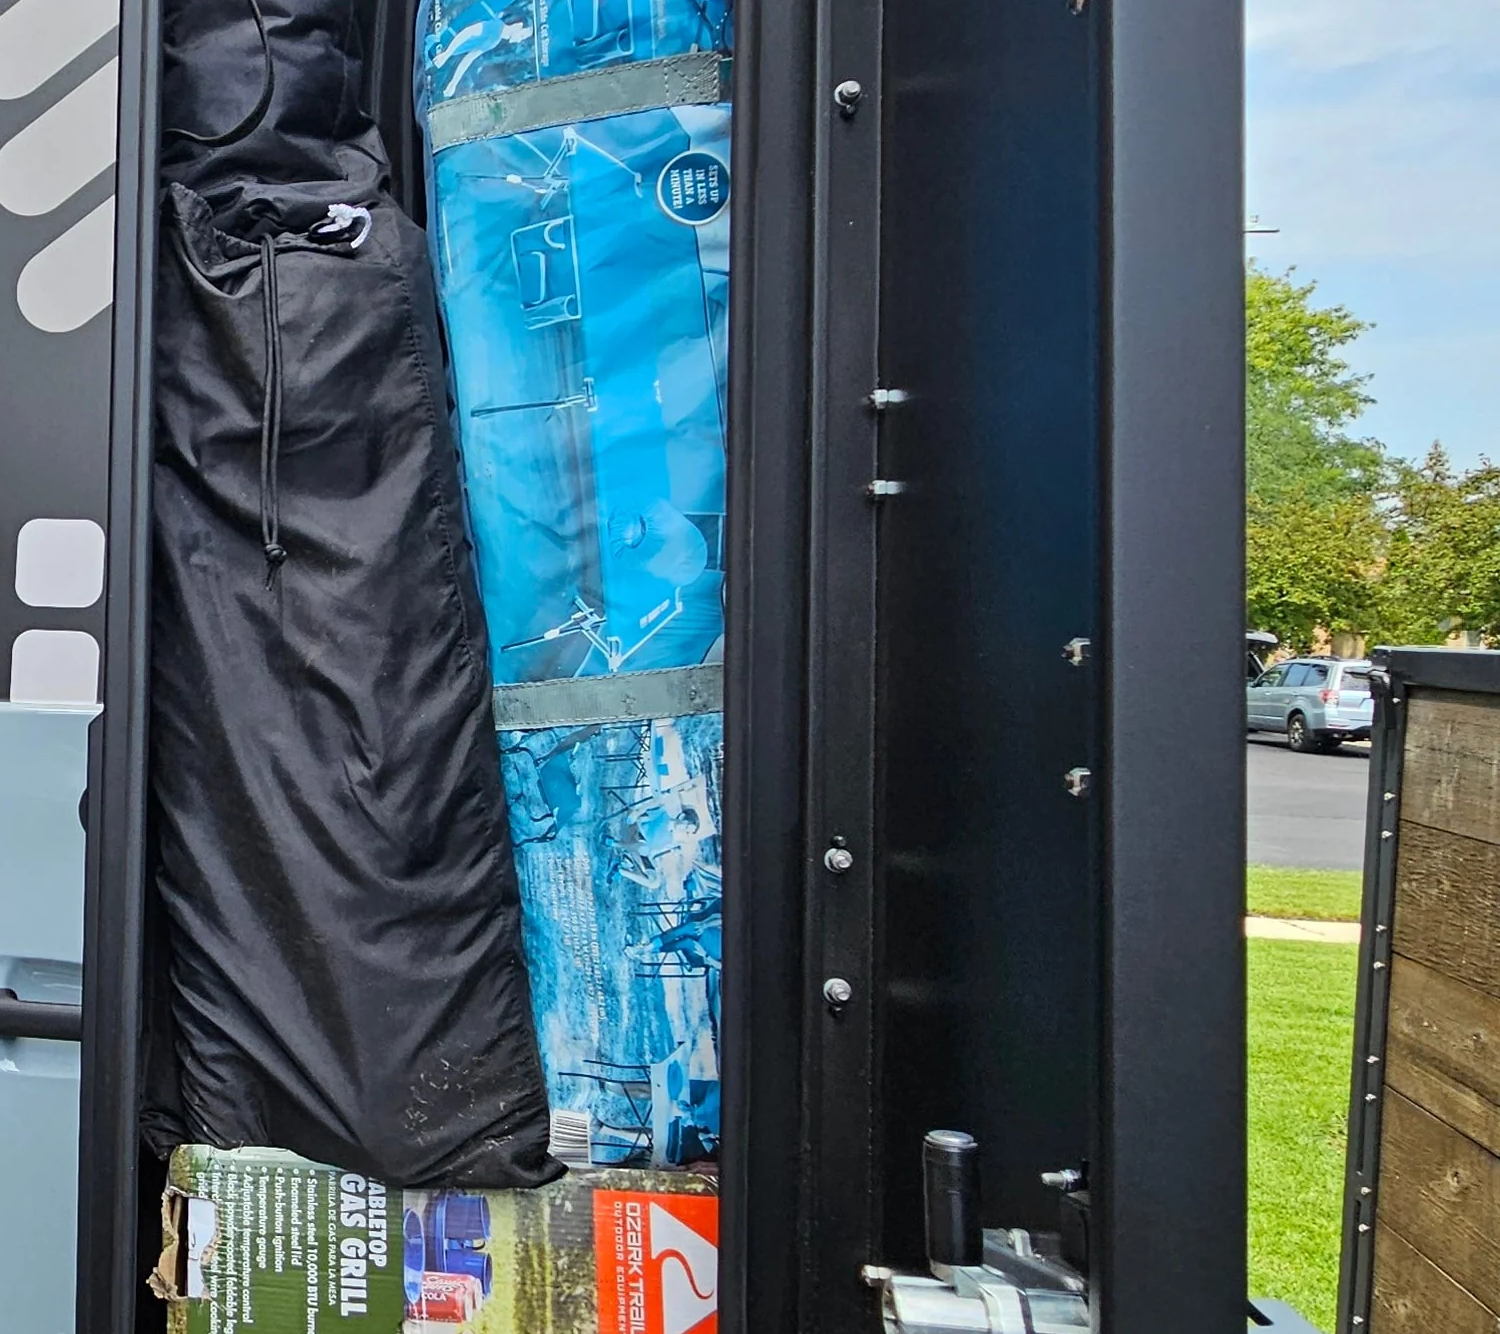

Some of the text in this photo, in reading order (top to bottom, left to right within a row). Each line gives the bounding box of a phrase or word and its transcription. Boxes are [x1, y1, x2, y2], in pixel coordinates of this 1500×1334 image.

[670, 169, 683, 209] MINUTE!
[683, 168, 695, 205] THAN A
[696, 169, 707, 205] IN LESS
[708, 165, 719, 203] SETS UP
[227, 1173, 237, 1199] Black
[307, 1178, 318, 1220] Stainless
[256, 1175, 269, 1269] Temperature gauge
[272, 1176, 285, 1272] Push-button ignition
[291, 1177, 302, 1265] Enameled steel lid
[308, 1223, 318, 1245] steel
[328, 1171, 337, 1306] PARRILLA DE GAS PARA LA MESA
[614, 1201, 624, 1260] OUTDOOR
[240, 1173, 253, 1323] Adjustable temperature control
[340, 1173, 367, 1317] GAS GRILL
[306, 1249, 318, 1283] 10,000
[226, 1277, 237, 1317] foldable
[308, 1286, 318, 1306] BTU
